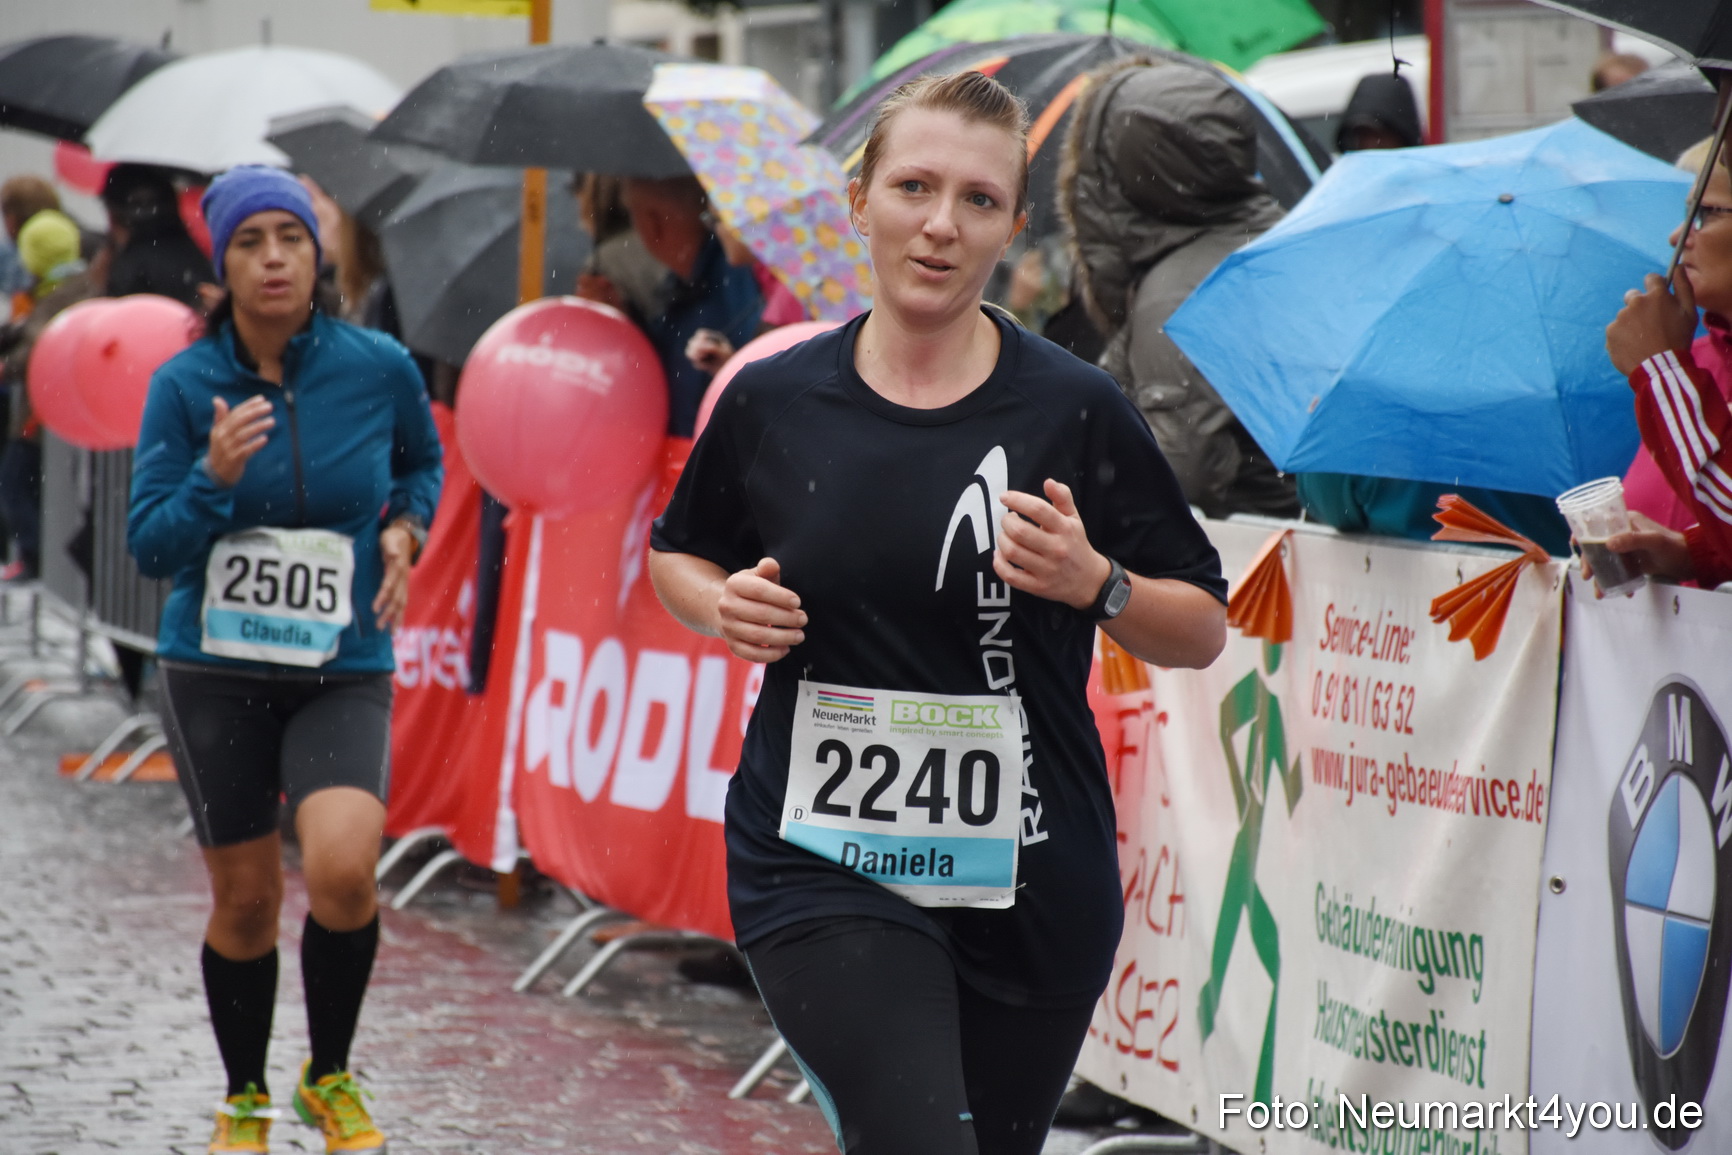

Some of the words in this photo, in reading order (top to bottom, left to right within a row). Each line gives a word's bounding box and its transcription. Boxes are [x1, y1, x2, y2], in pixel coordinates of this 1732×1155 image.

[222, 555, 338, 614] 2505
[240, 619, 312, 646] Claudia
[812, 708, 876, 726] NeuerMarkt
[891, 700, 1002, 729] BOCK
[890, 726, 924, 735] inspired
[926, 727, 936, 736] by
[939, 729, 963, 737] smart
[966, 731, 1004, 740] concepts
[811, 739, 1001, 827] 2240
[840, 841, 955, 877] Daniela
